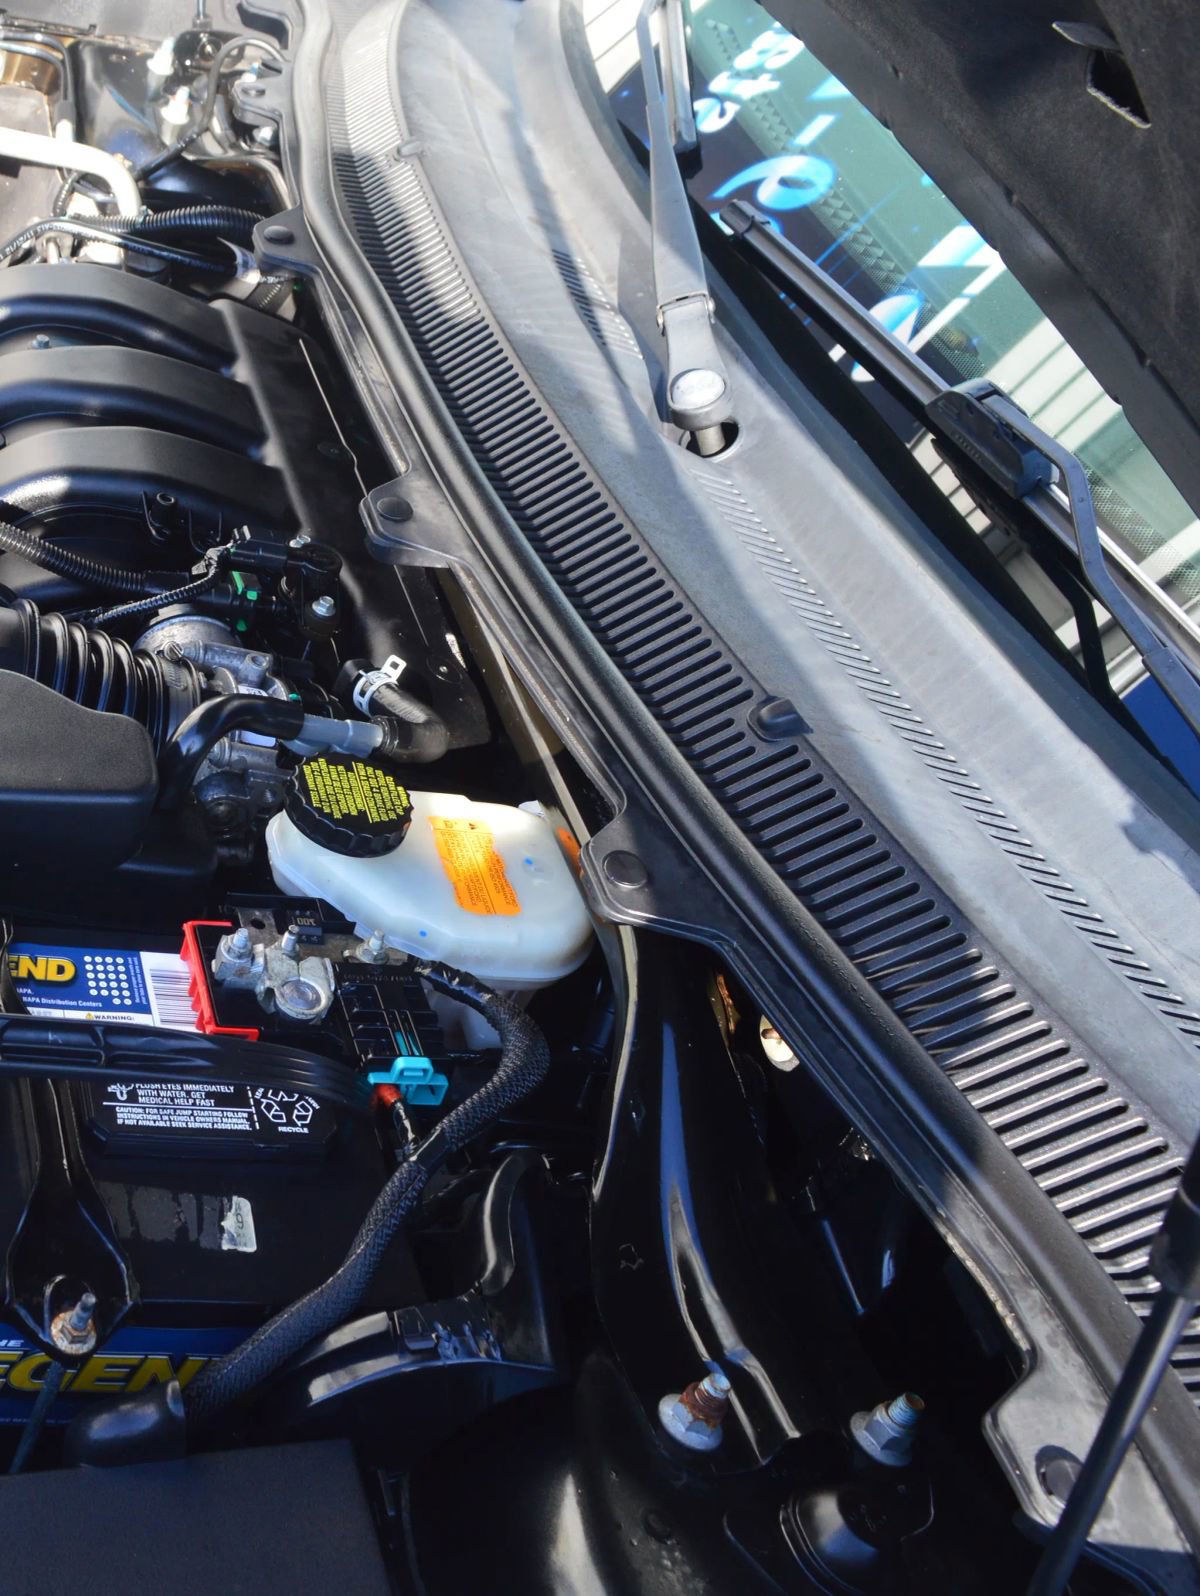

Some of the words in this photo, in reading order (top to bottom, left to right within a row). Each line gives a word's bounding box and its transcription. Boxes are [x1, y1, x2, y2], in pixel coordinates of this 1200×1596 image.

[355, 763, 366, 775] FROM
[394, 806, 403, 814] CAP
[41, 997, 77, 1006] Distribution
[78, 999, 103, 1007] Centers
[162, 1083, 182, 1091] EYES
[183, 1084, 235, 1093] IMMEDIATELY
[137, 1089, 158, 1097] WITH
[191, 1091, 206, 1099] GET
[138, 1097, 173, 1105] MEDICAL
[175, 1098, 194, 1106] HELP
[196, 1099, 215, 1107] FAST
[278, 1126, 310, 1134] RECYCLE
